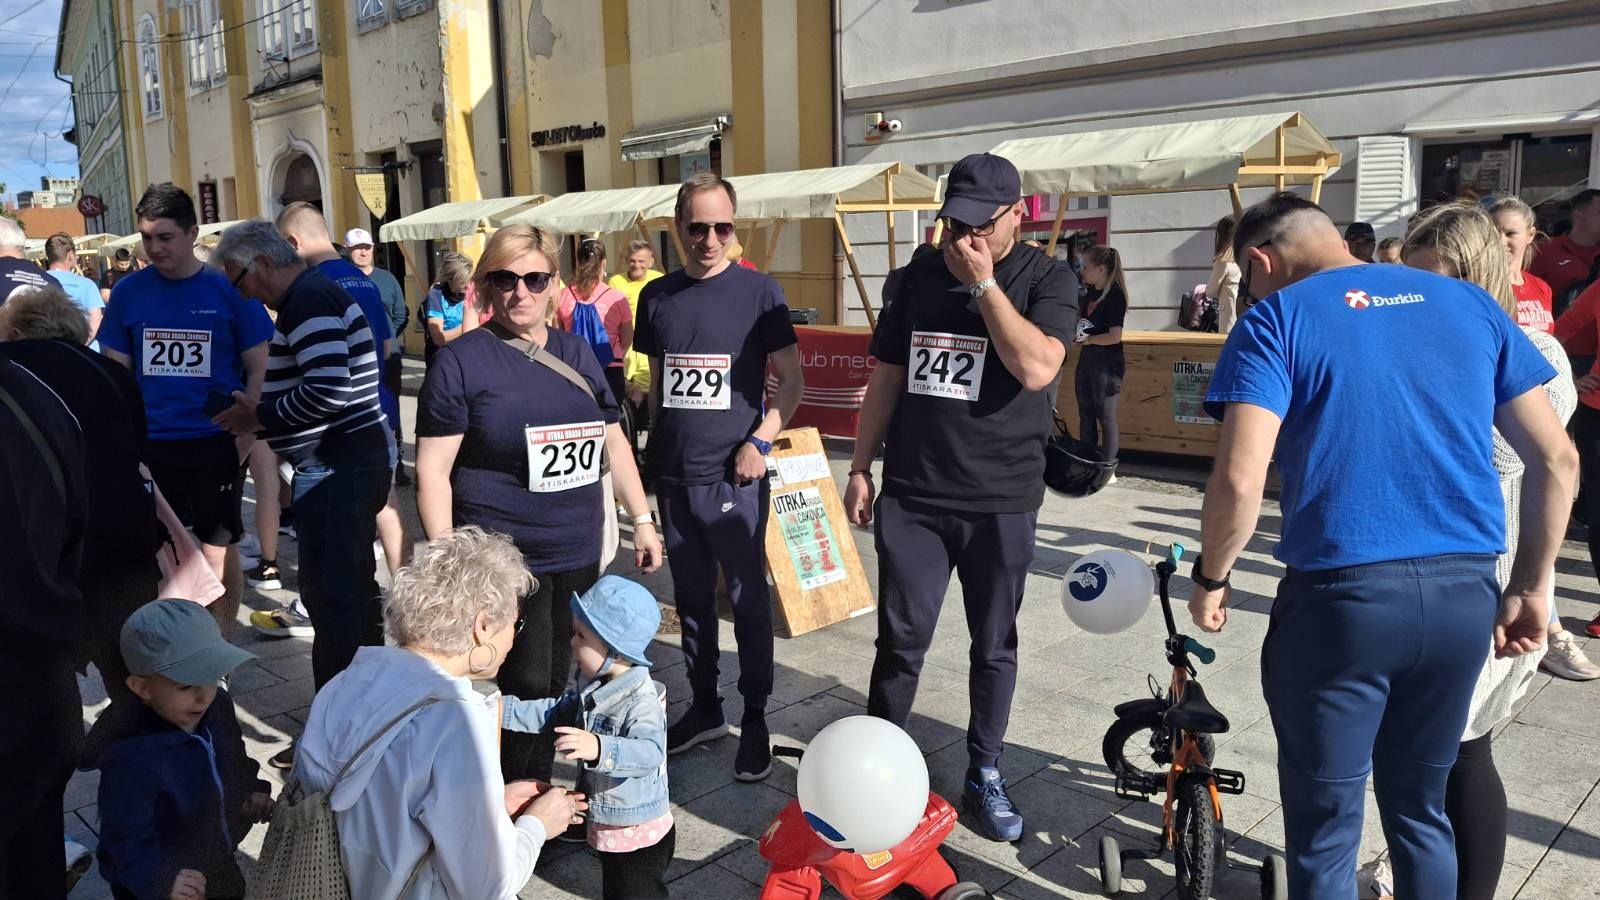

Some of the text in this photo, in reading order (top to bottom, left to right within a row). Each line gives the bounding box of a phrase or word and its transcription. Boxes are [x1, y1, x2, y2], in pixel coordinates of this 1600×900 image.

[1371, 293, 1425, 307] Đurkin
[150, 341, 204, 367] 203
[800, 350, 827, 367] lub
[914, 348, 975, 387] 242
[1174, 362, 1202, 374] UTRKA
[670, 368, 723, 398] 229
[540, 439, 596, 479] 230
[781, 457, 826, 480] PRIJAVE
[772, 491, 807, 514] UTRKA
[796, 506, 827, 523] ČAKOVCA
